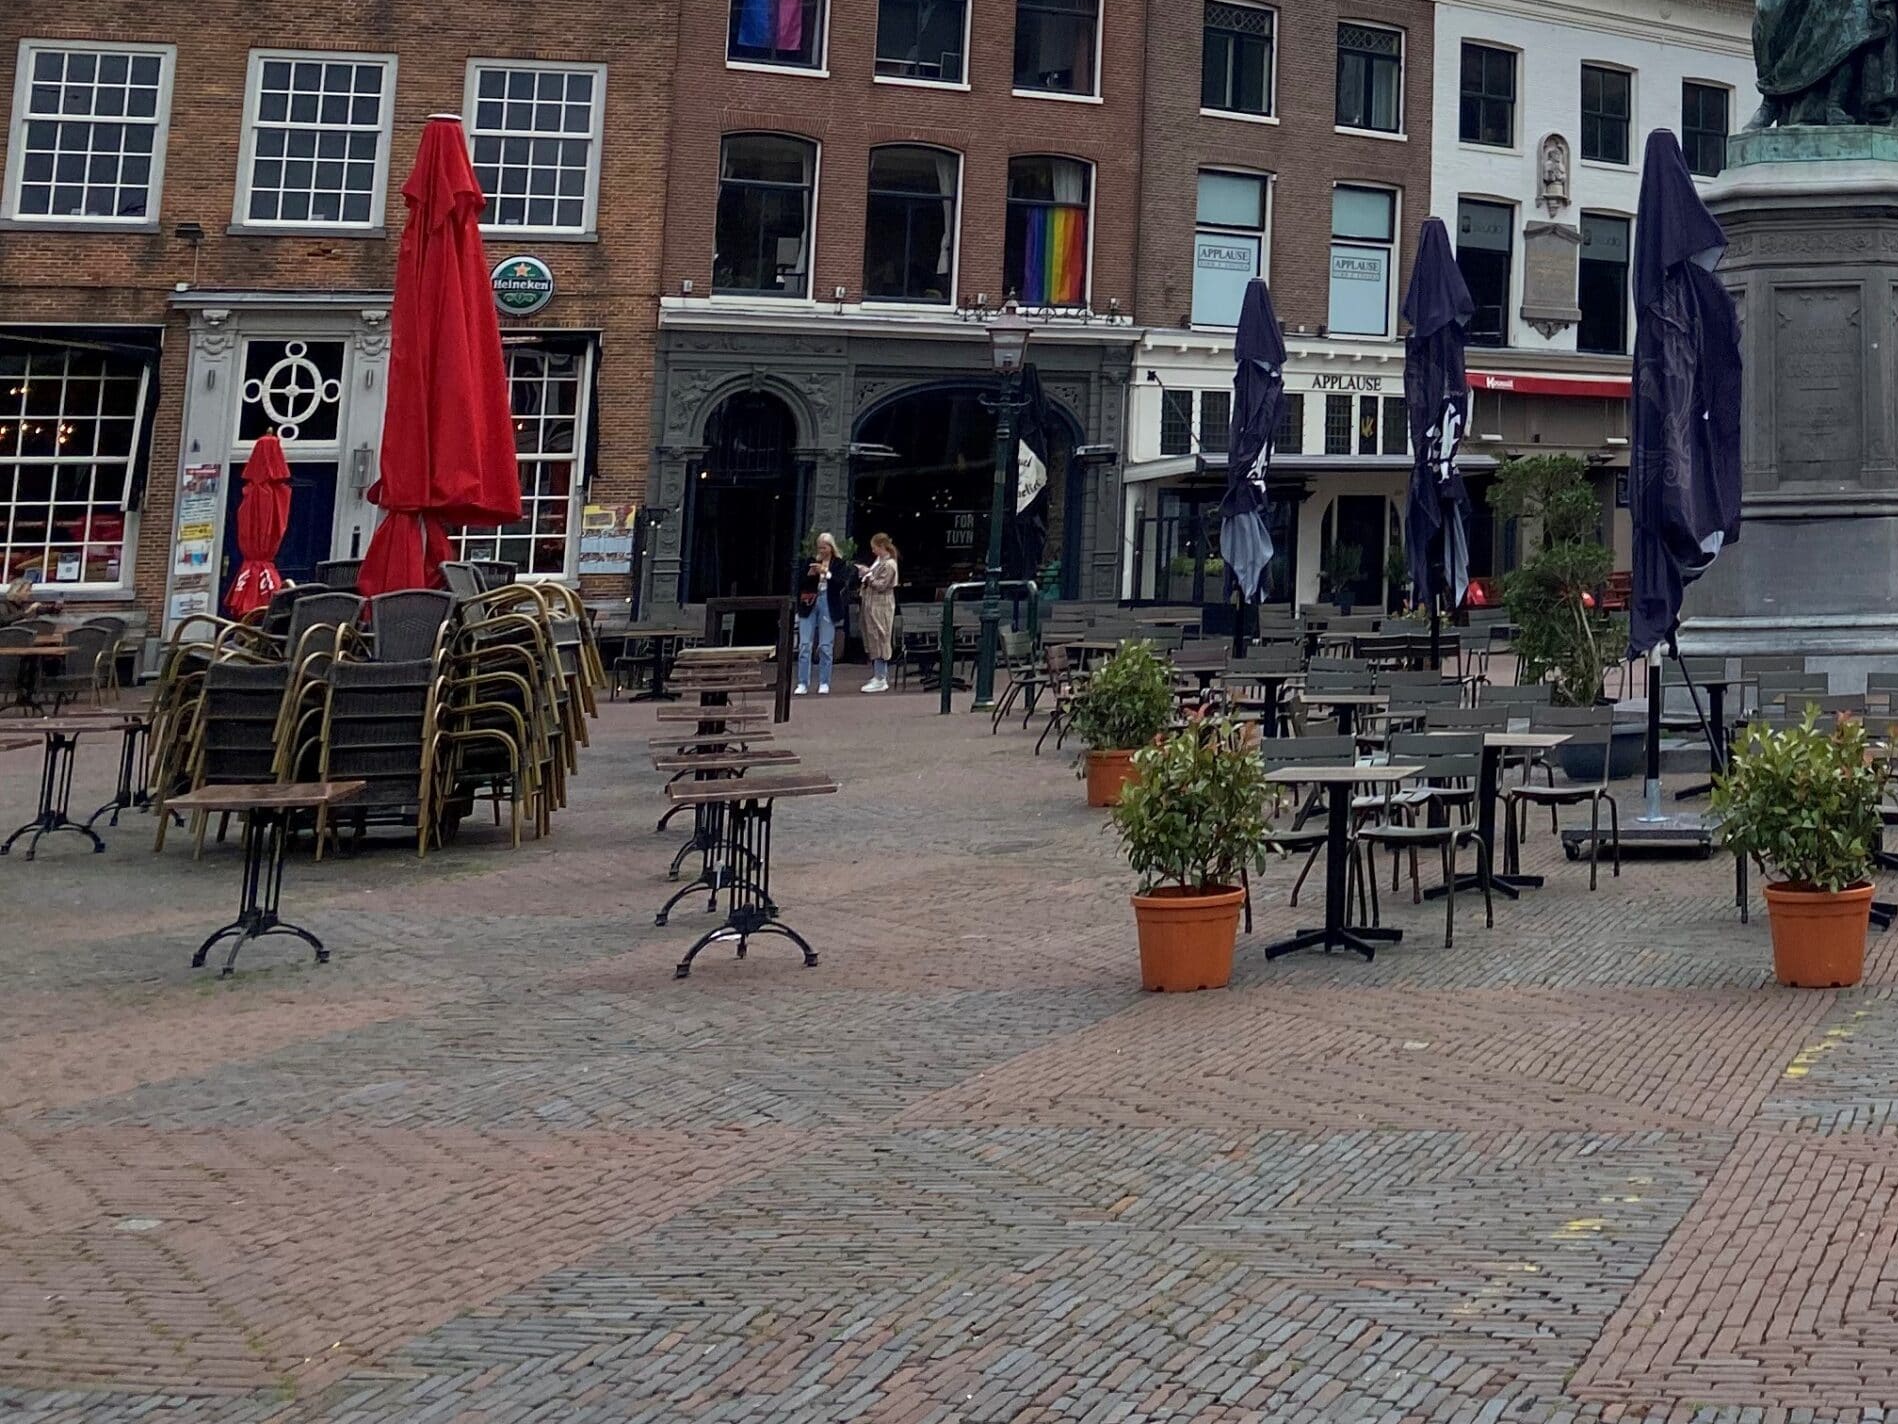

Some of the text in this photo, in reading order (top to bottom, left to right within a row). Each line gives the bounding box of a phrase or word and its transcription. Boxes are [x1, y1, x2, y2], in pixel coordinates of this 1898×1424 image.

[1200, 248, 1249, 261] APPLAUSE
[1335, 259, 1379, 272] APPLAUSE
[493, 279, 549, 290] Heineken
[1311, 374, 1382, 391] APPLAUSE
[954, 514, 974, 528] FOR
